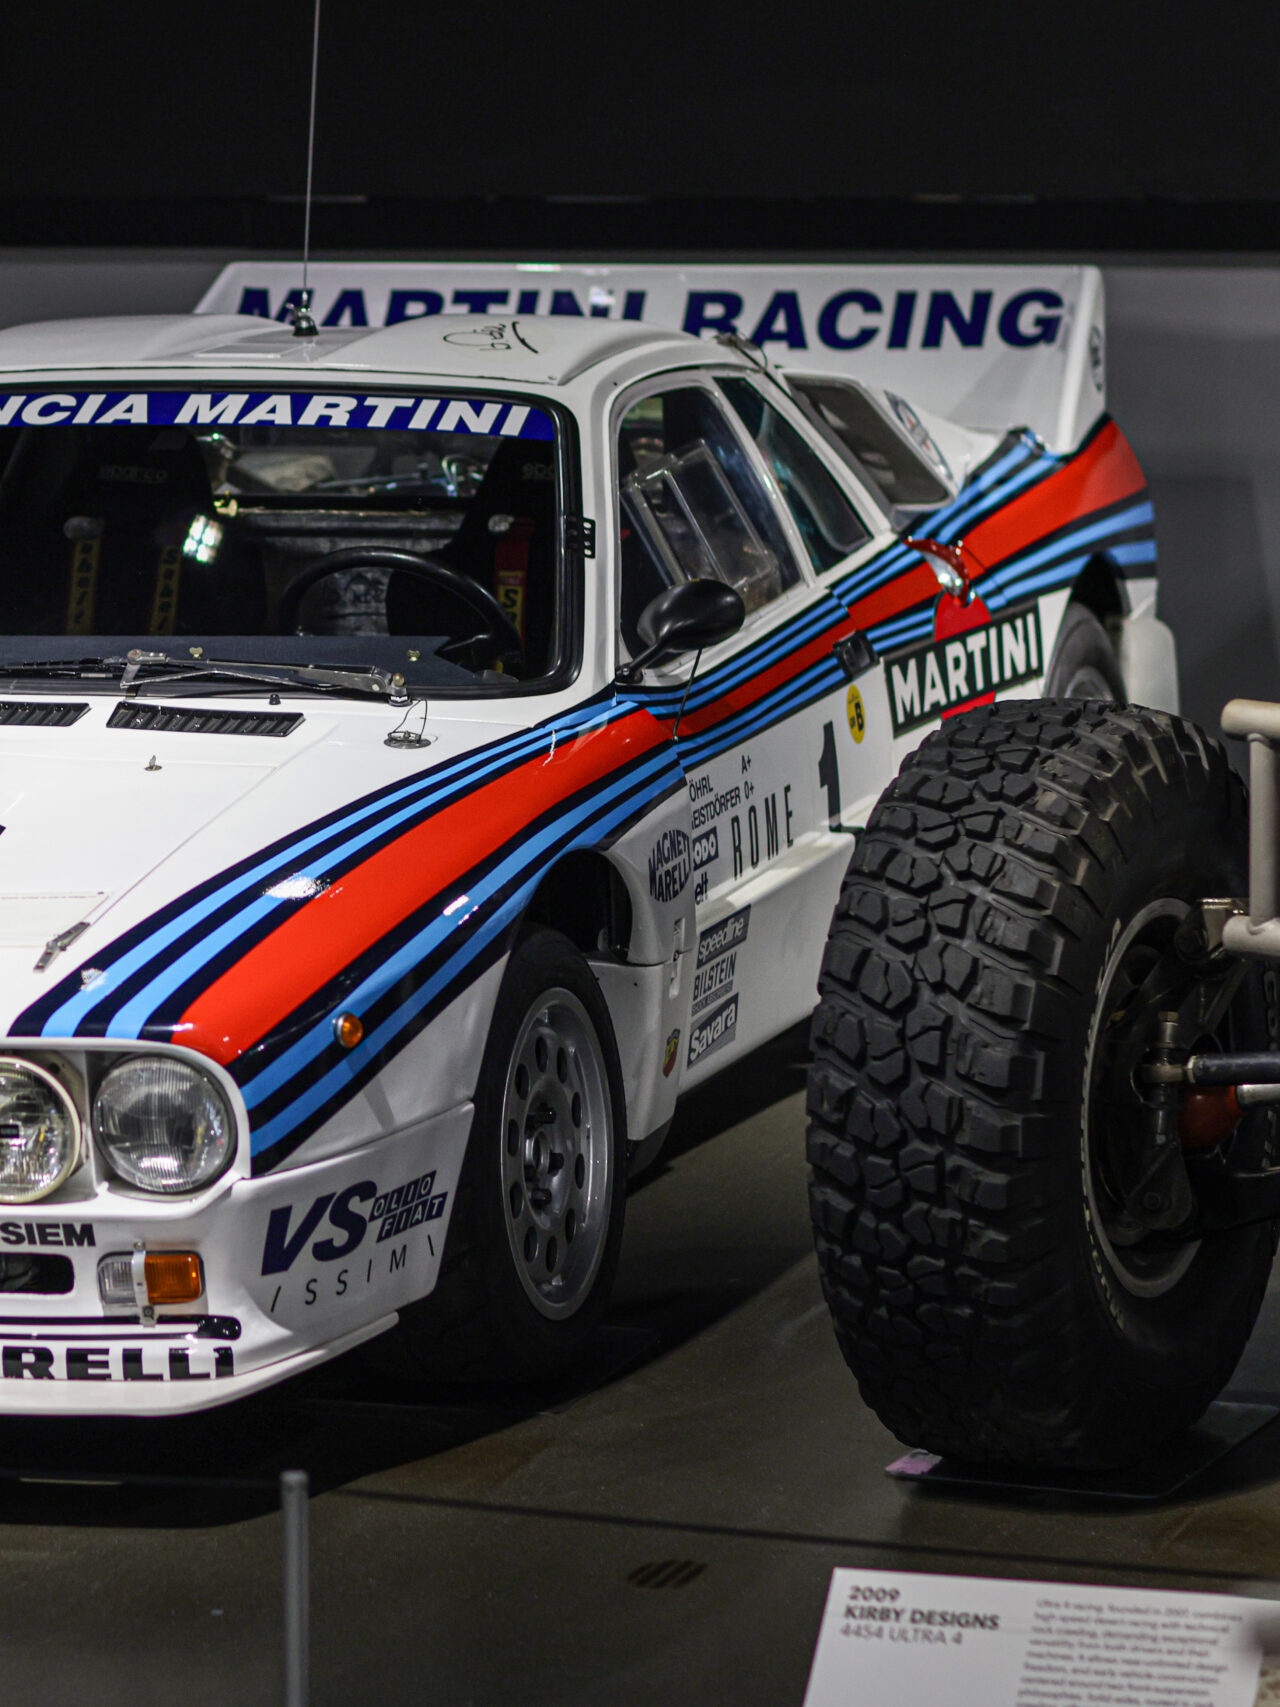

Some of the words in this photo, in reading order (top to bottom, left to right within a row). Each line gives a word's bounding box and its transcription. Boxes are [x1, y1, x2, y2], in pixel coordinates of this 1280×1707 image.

[681, 288, 1064, 351] RACING
[174, 393, 531, 437] MARTINI
[890, 612, 1040, 725] MARTINI
[688, 775, 714, 802] ÖHRL
[692, 786, 742, 830] EISTDÖRFER
[731, 784, 794, 881] ROME
[699, 917, 745, 963] speedline
[693, 951, 737, 1001] BILSTEIN
[689, 1002, 737, 1061] Savara
[372, 1174, 433, 1219] OLIO
[383, 1195, 445, 1238] FIAT
[0, 1222, 97, 1248] SIEM
[260, 1180, 378, 1277] VS
[848, 1585, 901, 1603] 2009
[844, 1604, 907, 1623] KIRBY
[909, 1608, 1000, 1631] DESIGNS
[888, 1626, 948, 1645] ULTRA
[951, 1630, 964, 1646] 4
